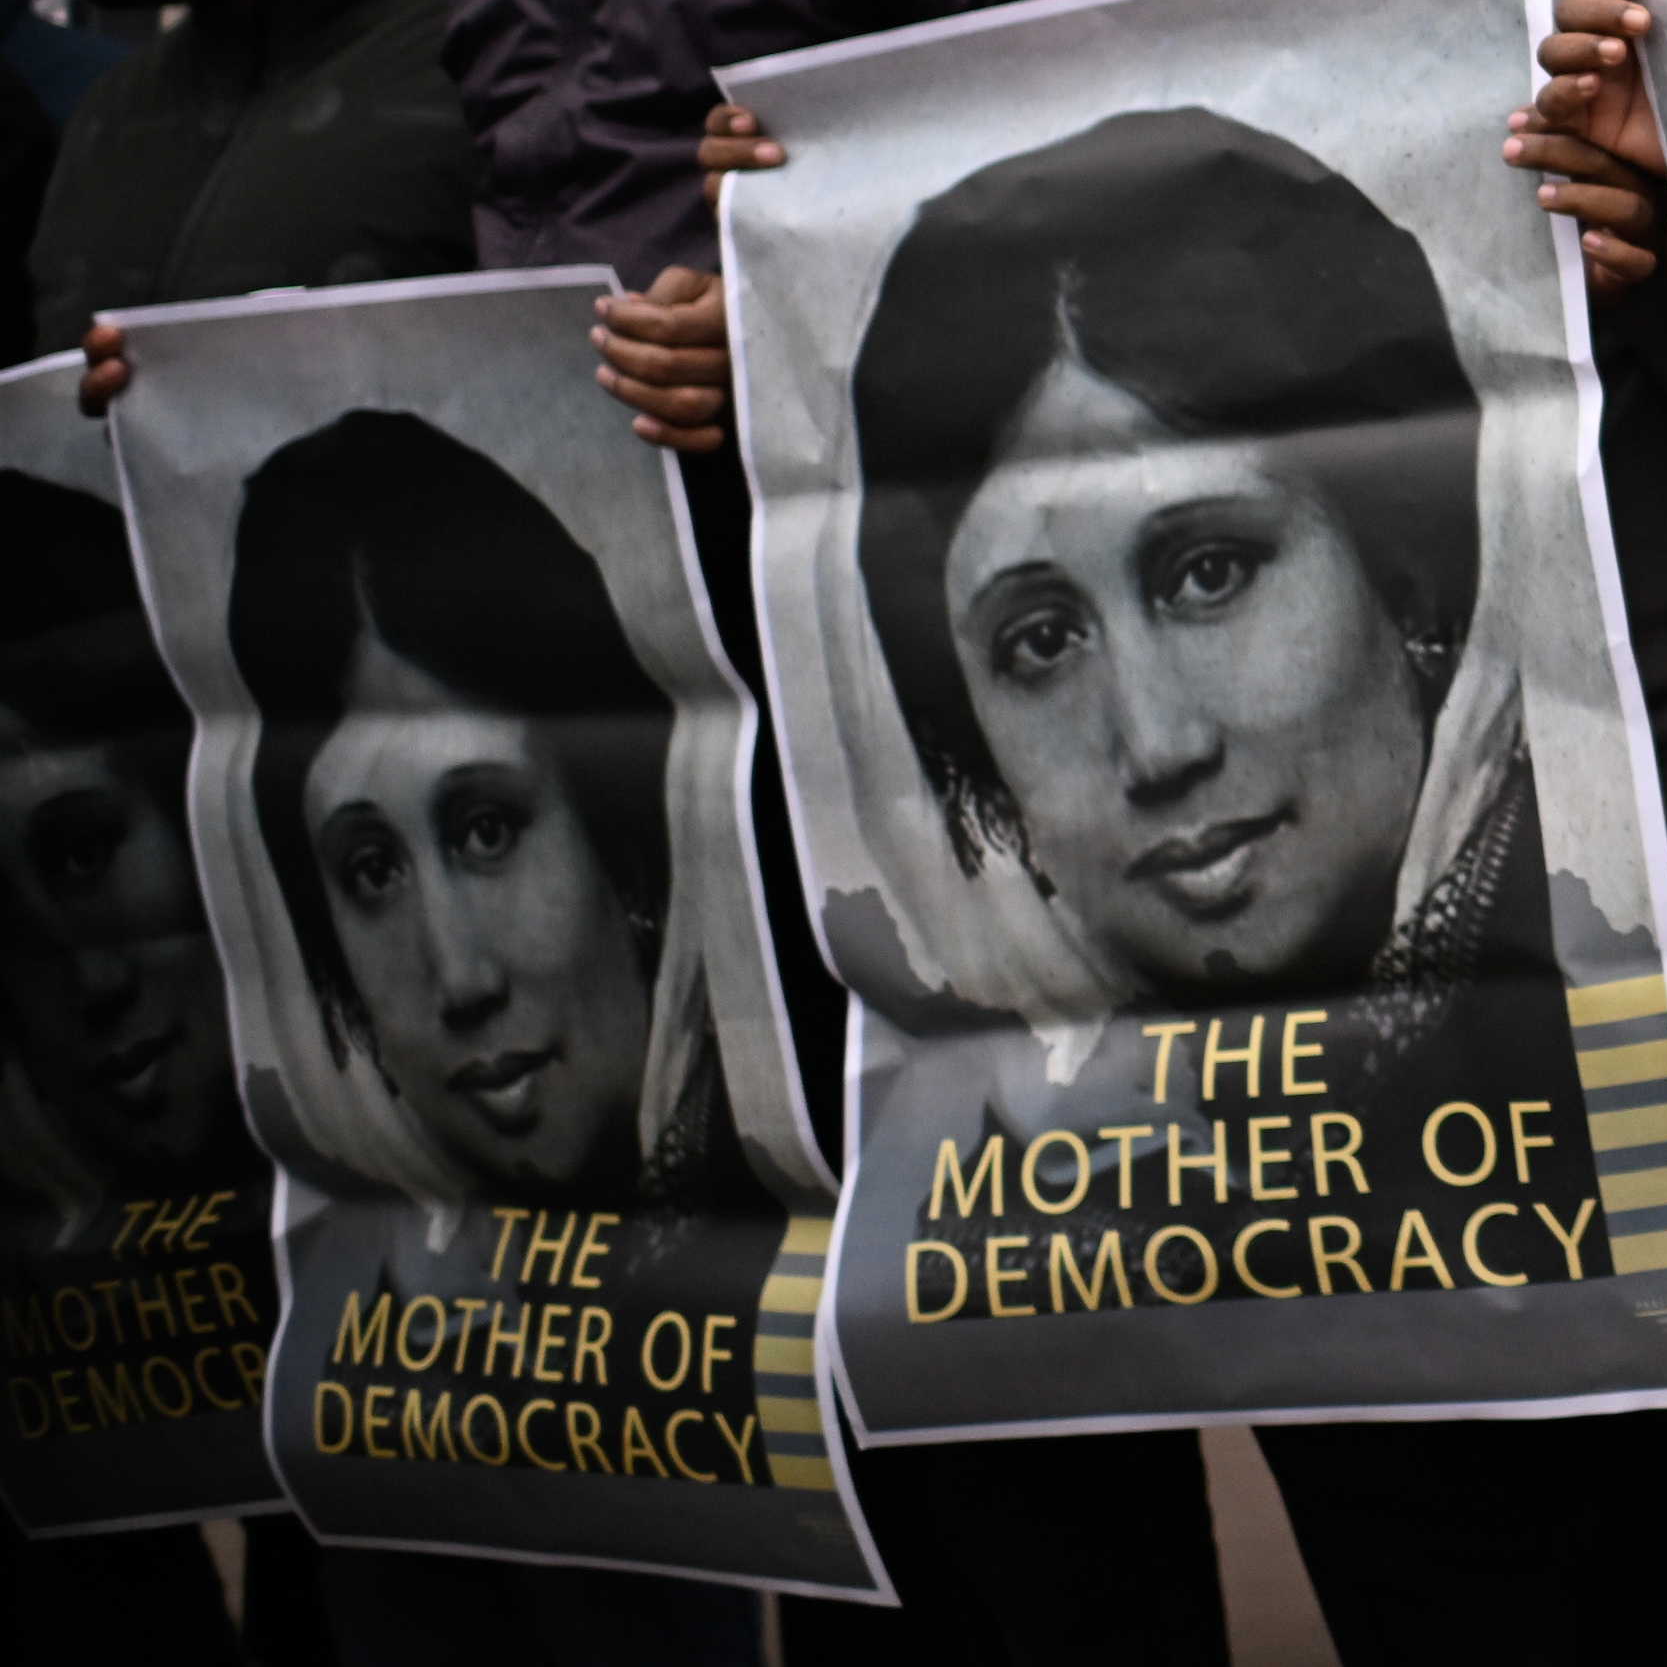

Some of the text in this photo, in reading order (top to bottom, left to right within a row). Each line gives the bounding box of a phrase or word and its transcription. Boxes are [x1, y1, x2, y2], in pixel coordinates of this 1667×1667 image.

[1142, 1009, 1328, 1104] THE
[928, 1100, 1555, 1220] MOTHER OF
[112, 1190, 238, 1257] THE
[491, 1207, 621, 1289] THE
[905, 1198, 1596, 1324] DEMOCRACY
[2, 1262, 260, 1360] MOTHER
[333, 1292, 737, 1393] MOTHER OF
[8, 1340, 266, 1441] DEMOCR
[314, 1381, 756, 1484] DEMOCRACY
